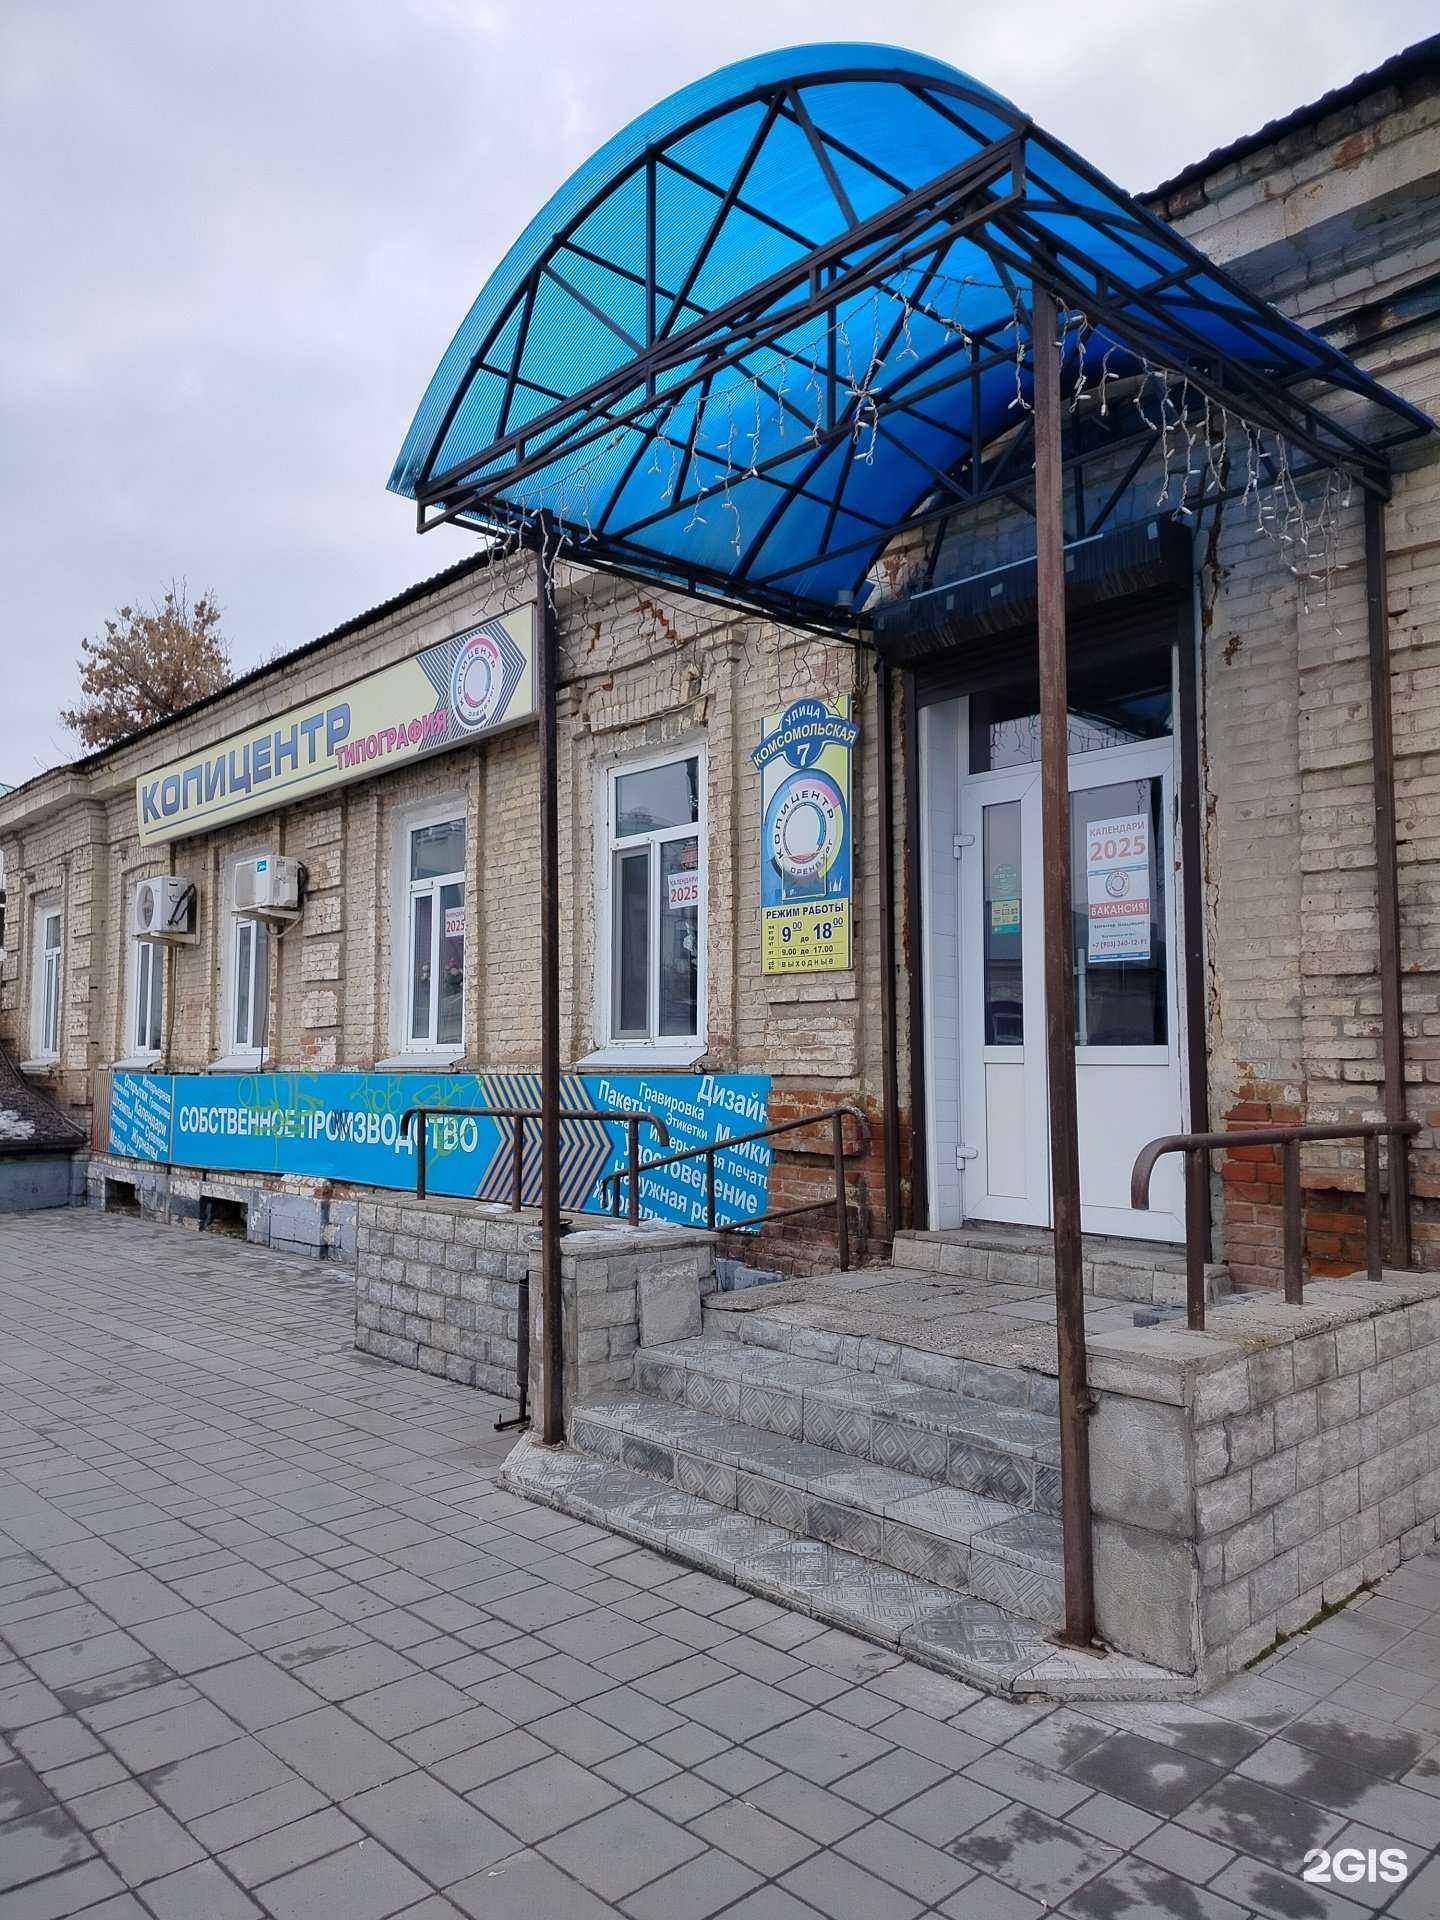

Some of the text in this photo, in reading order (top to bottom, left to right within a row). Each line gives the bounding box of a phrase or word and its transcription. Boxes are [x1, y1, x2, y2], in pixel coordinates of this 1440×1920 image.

[785, 704, 821, 726] УЛИЦА
[335, 708, 449, 770] ТИПОГРАФИЯ
[752, 722, 857, 767] КОМСОМОЛЬСКАЯ
[142, 702, 351, 824] КОПИЦЕНТР
[796, 743, 810, 766] 7
[774, 789, 835, 860] КОПИЦЕНТР
[1089, 820, 1145, 837] КАЛЕНДАРИ
[1090, 834, 1146, 862] 2025
[670, 885, 698, 902] 2025
[766, 902, 844, 919] РЕЖИМ РАБОТЫ
[446, 919, 465, 933] 2025
[782, 948, 797, 956] 9.00
[814, 945, 833, 953] 17.00
[638, 1082, 705, 1121] Гравировка
[134, 1097, 167, 1137] Календари
[179, 1105, 296, 1139] СОБСТВЕННОЕ
[665, 1112, 708, 1140] Этикетки
